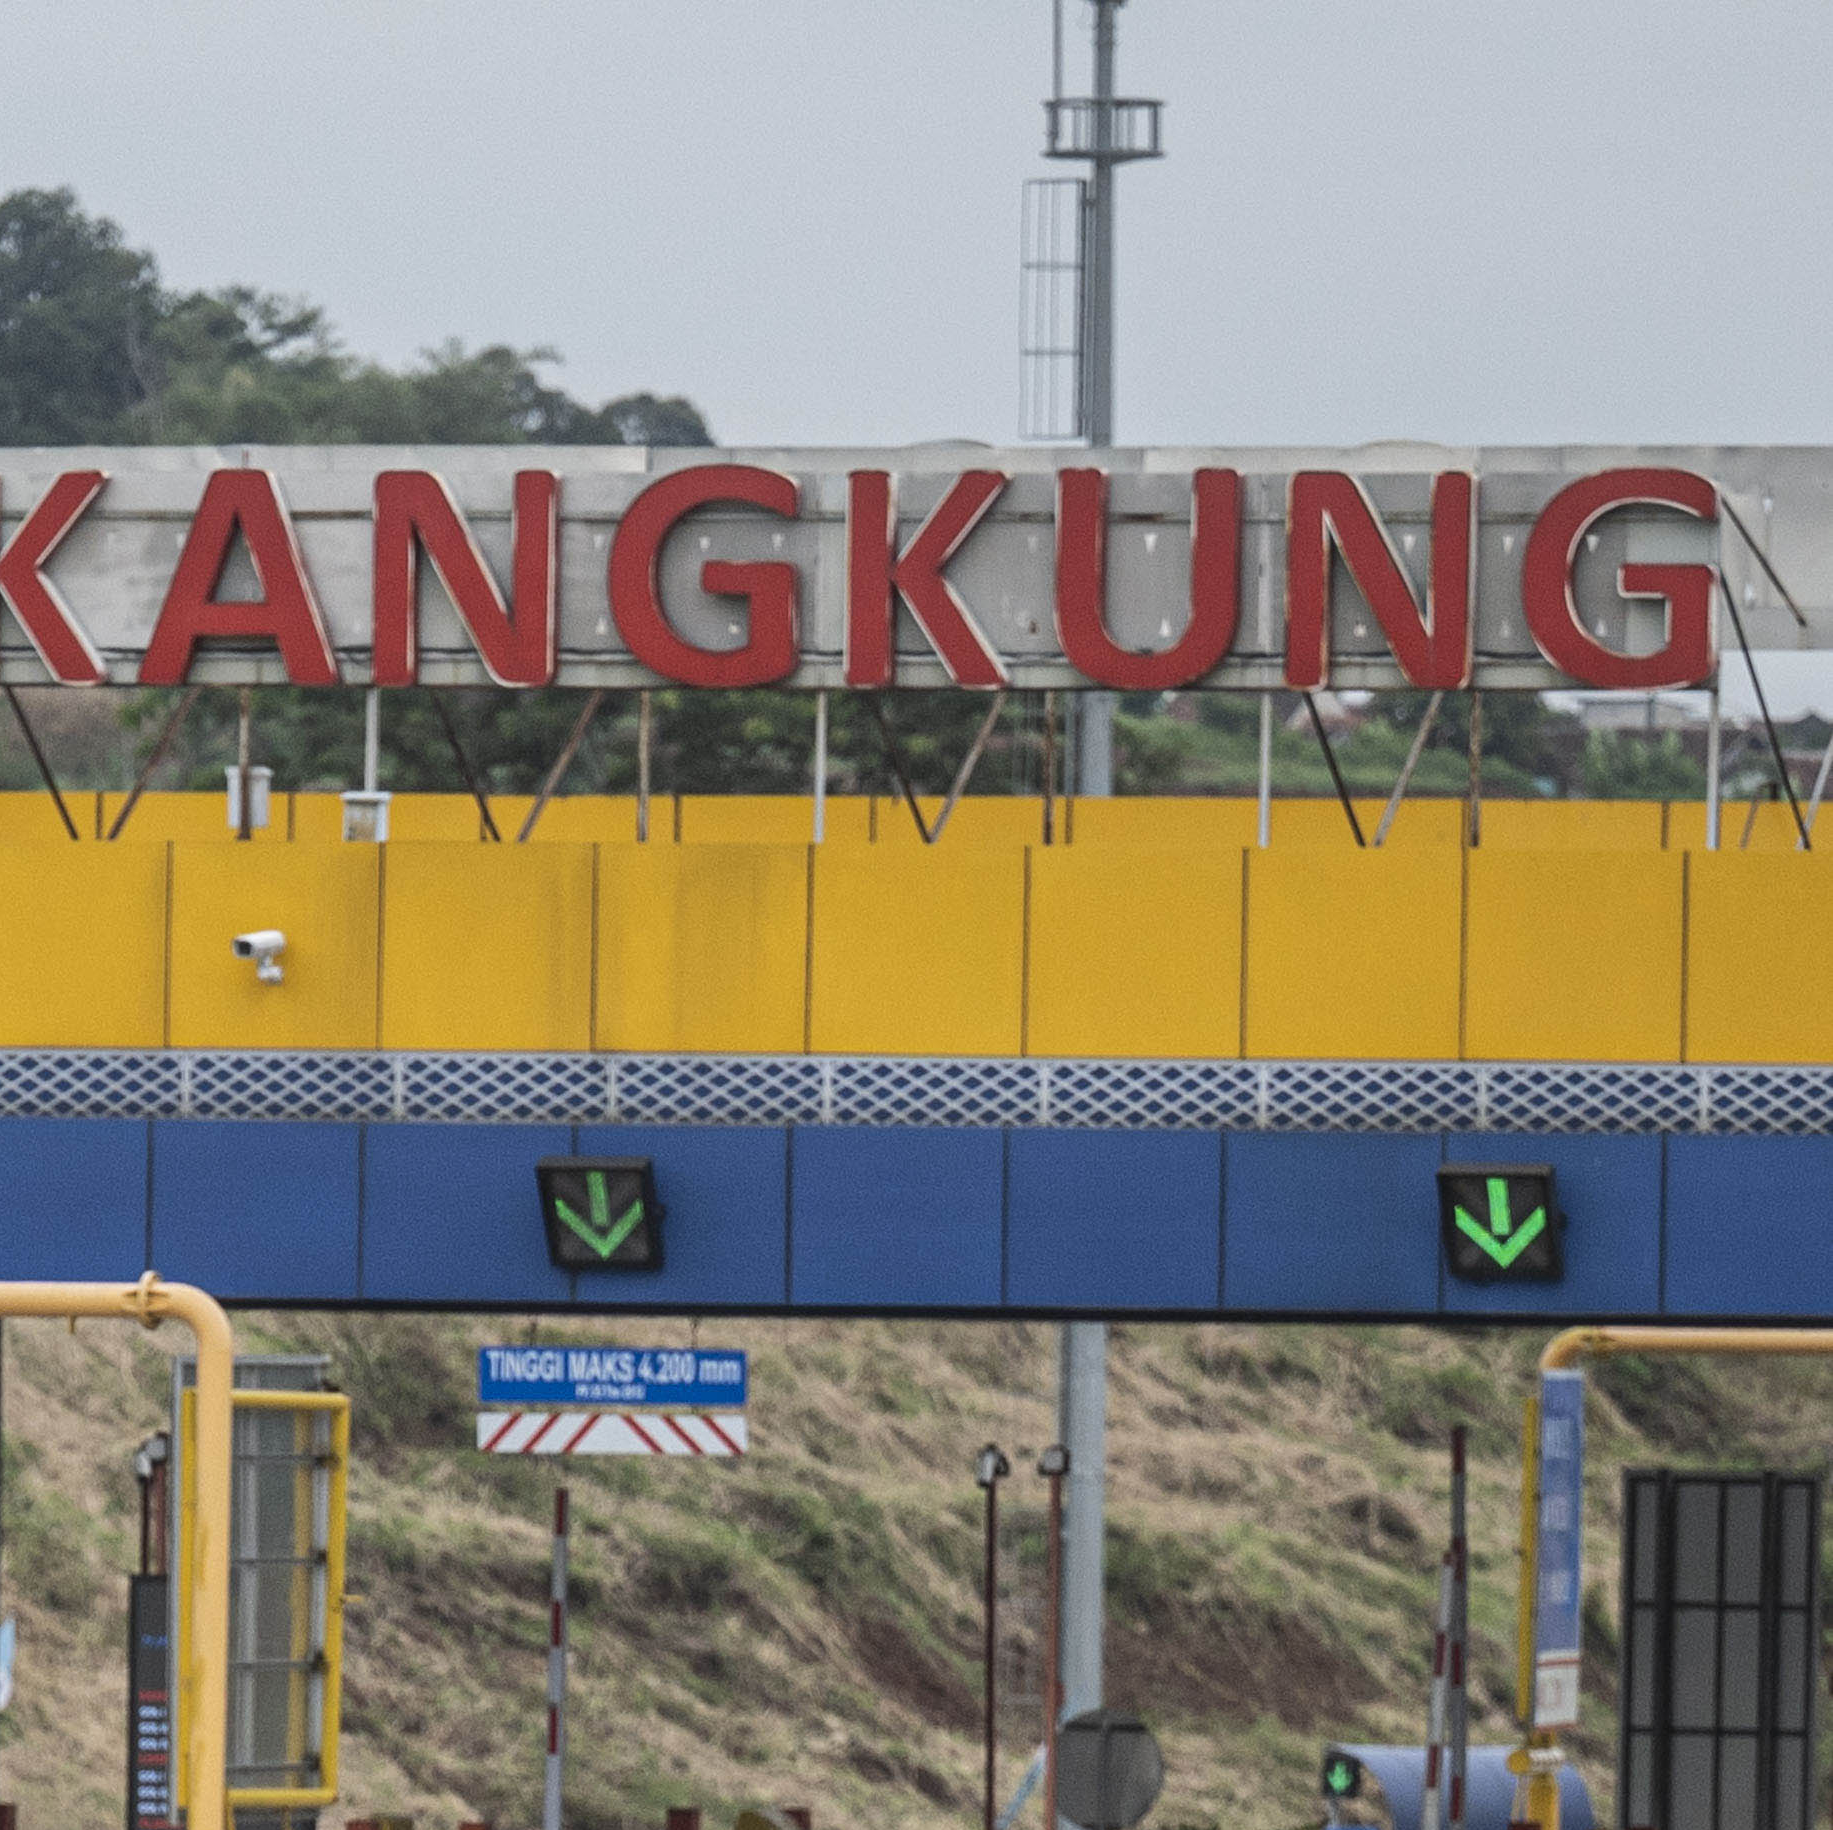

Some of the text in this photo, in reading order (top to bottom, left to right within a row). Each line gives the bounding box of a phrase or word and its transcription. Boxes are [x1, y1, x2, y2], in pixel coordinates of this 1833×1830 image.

[486, 1350, 742, 1385] TINGGI MAKS 4.200 mm
